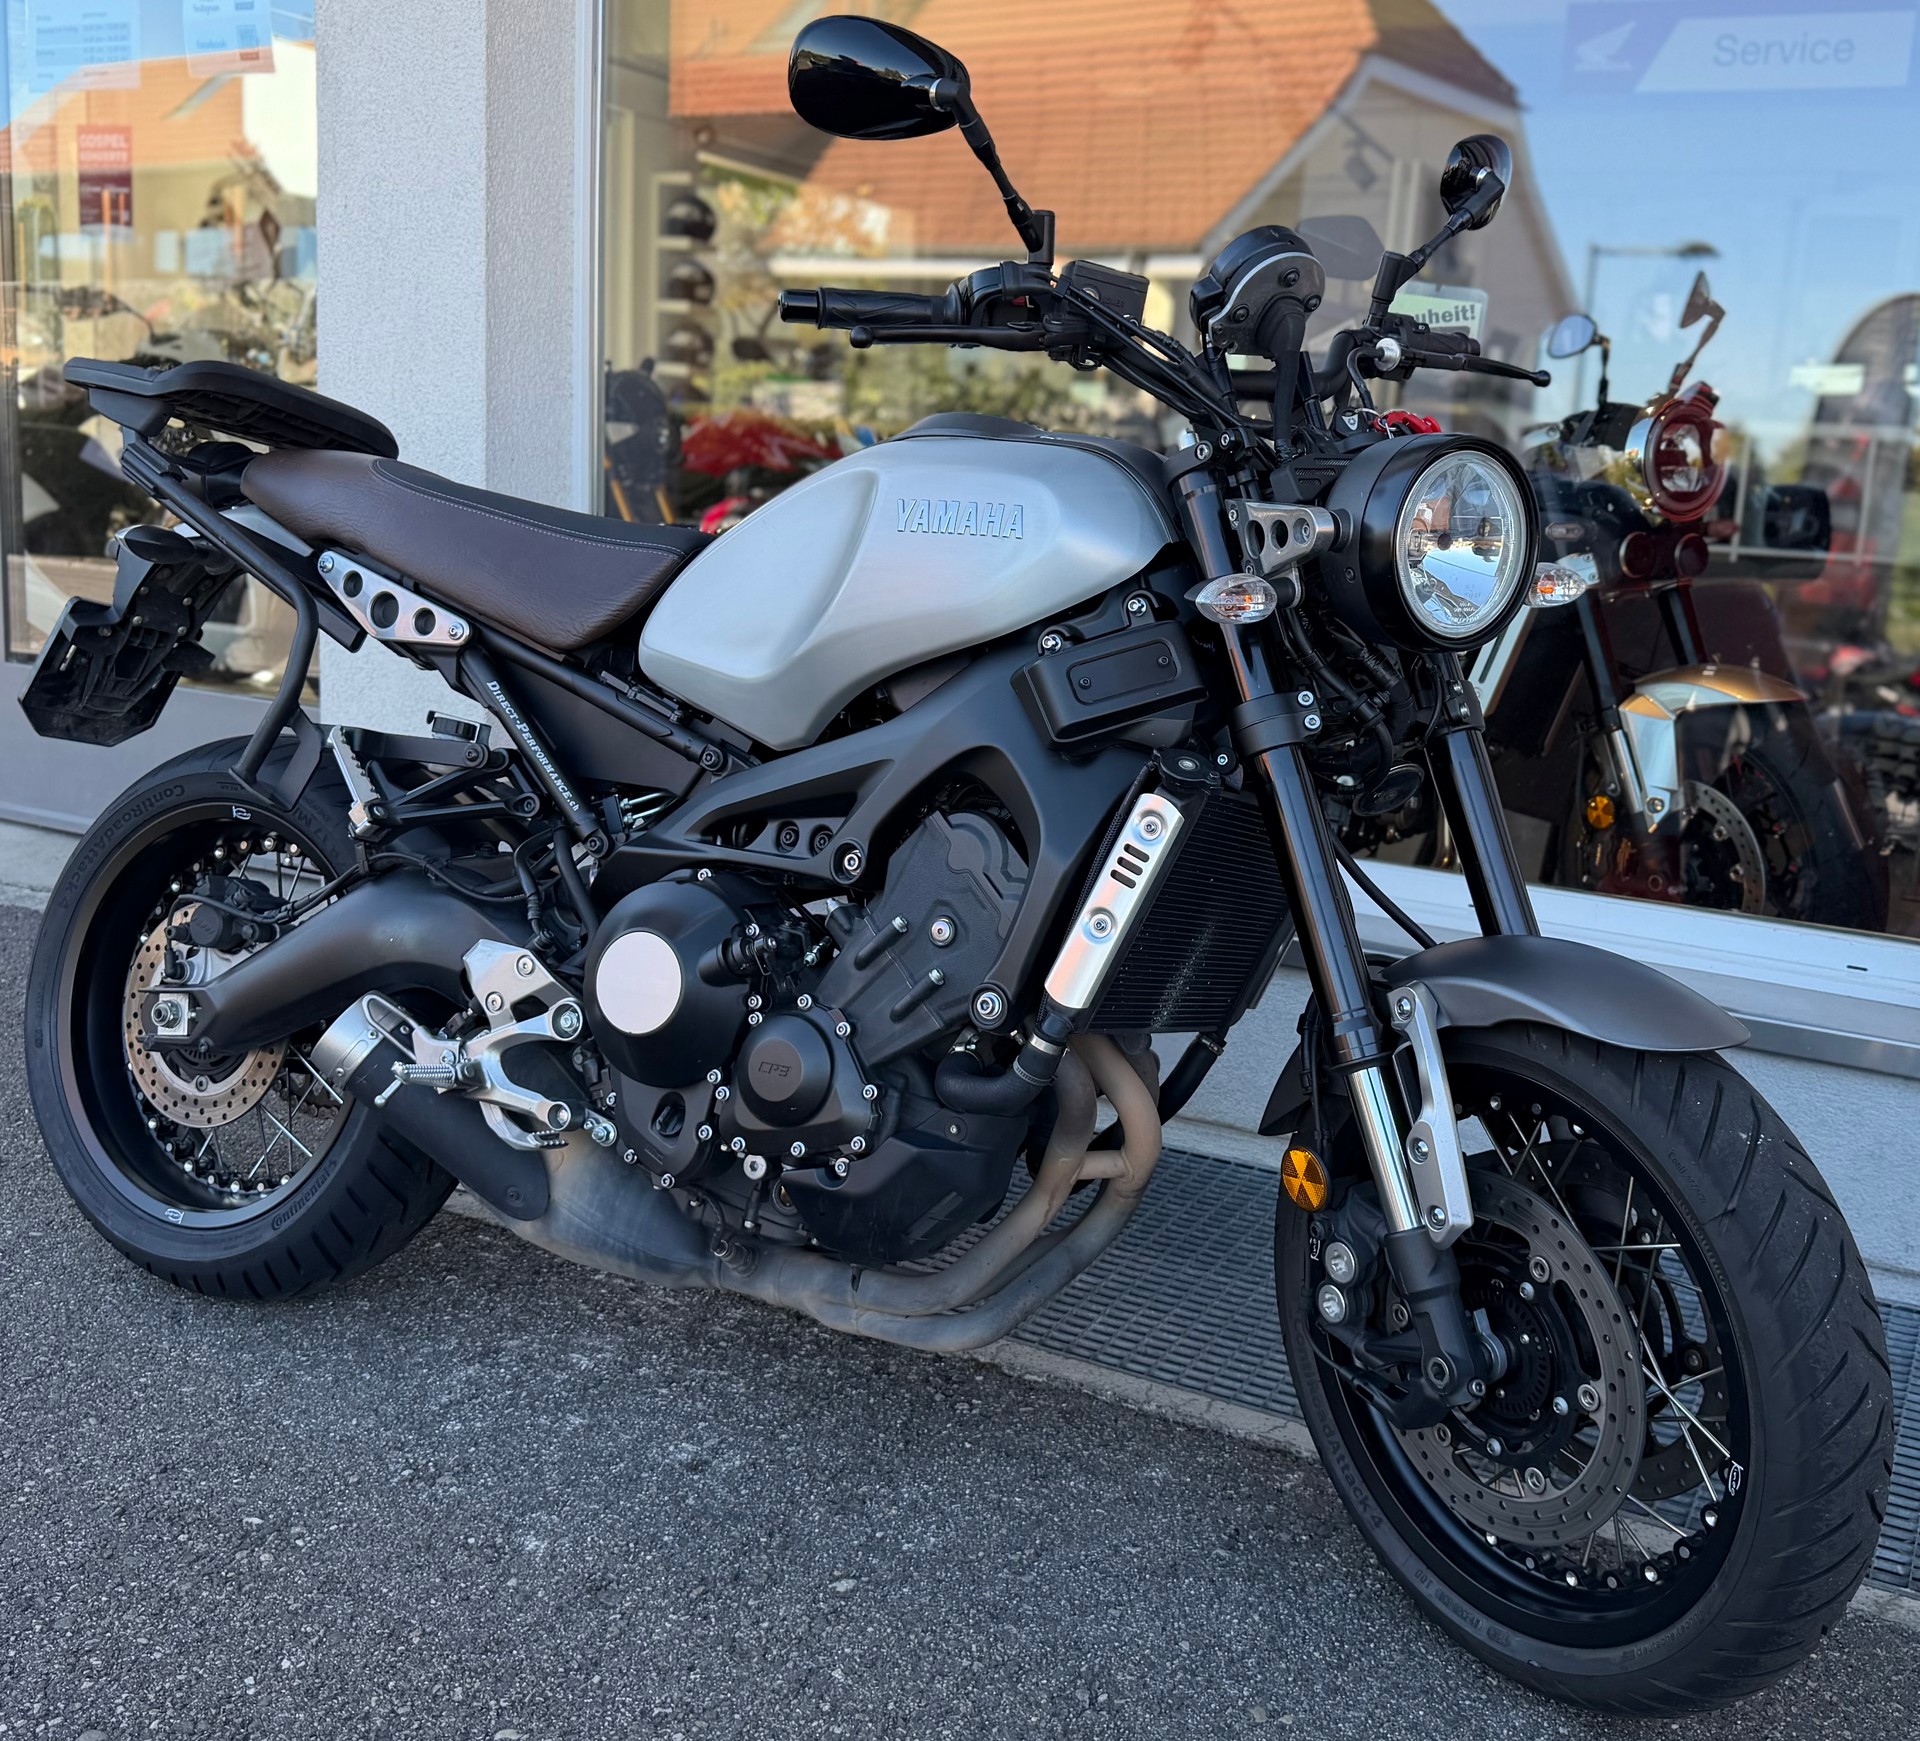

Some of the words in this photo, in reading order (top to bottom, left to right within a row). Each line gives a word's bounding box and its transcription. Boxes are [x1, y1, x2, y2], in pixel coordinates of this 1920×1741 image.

[1712, 32, 1856, 67] Service
[896, 498, 1024, 540] YAMAHA
[757, 1061, 793, 1078] CP3
[271, 1166, 332, 1231] Continental
